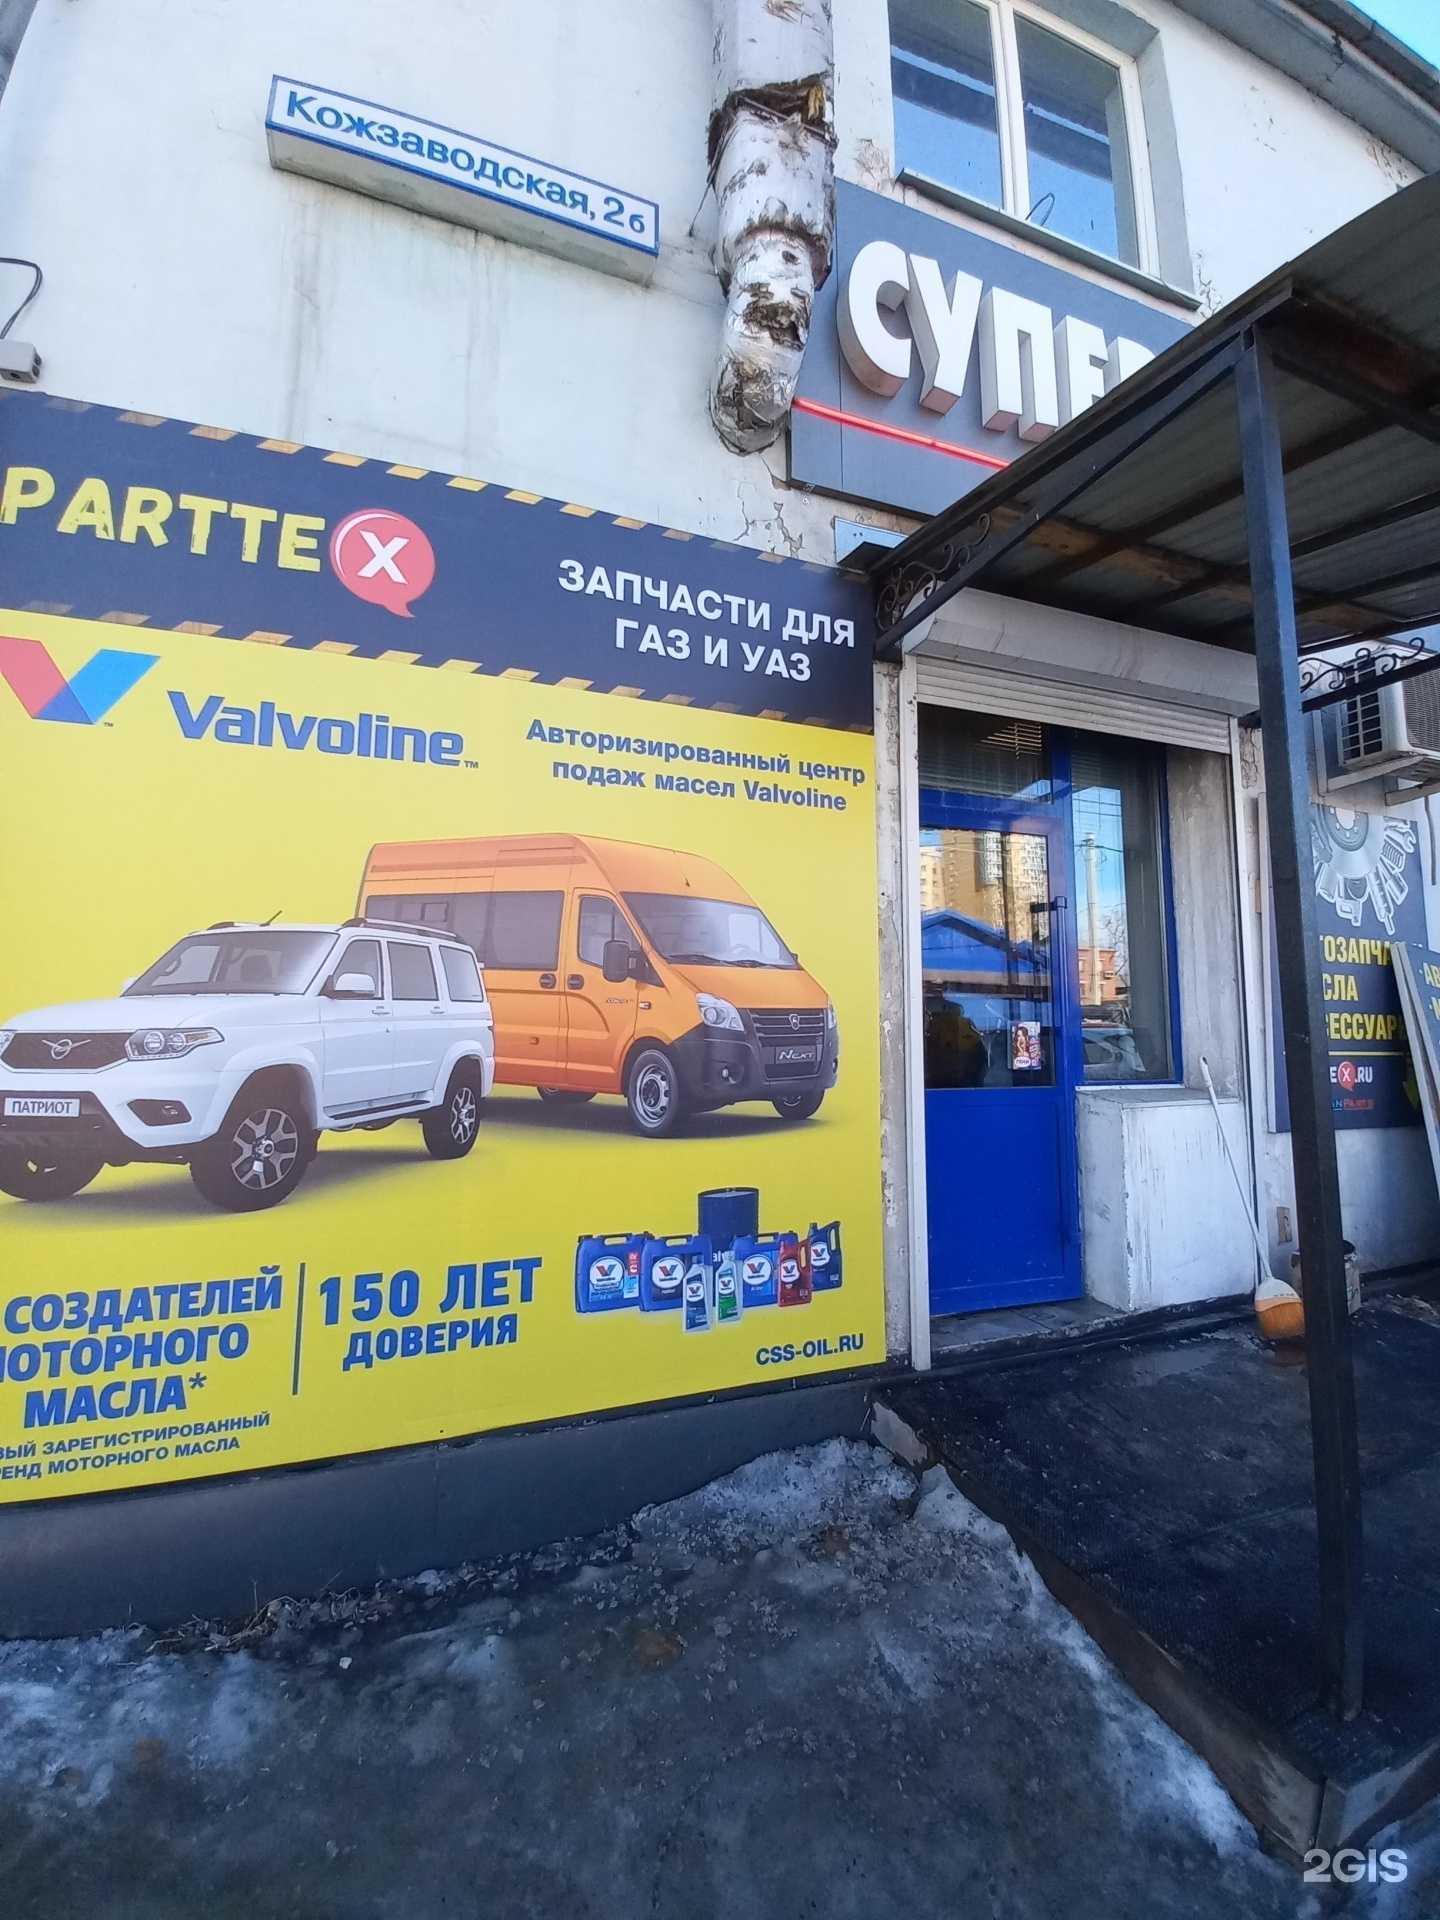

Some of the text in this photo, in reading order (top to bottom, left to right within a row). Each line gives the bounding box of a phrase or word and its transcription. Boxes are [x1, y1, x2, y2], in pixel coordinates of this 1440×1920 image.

[287, 90, 646, 233] Кожзаводская, 2б
[558, 559, 855, 648] ЗАПЧАСТИ ДЛЯ
[615, 618, 812, 682] ГАЗ И УАЗ
[526, 718, 865, 786] Авторизированный центр
[552, 760, 847, 811] подаж масел Valvoline
[12, 1100, 73, 1114] ПАТРИОТ
[3, 1265, 283, 1335] СОЗДАТЕЛЕЙ
[319, 1257, 543, 1326] 150 ЛЕТ
[342, 1313, 518, 1372] ДОВЕРИЯ
[755, 1333, 864, 1366] CSS-OIL.RU
[0, 1436, 241, 1480] ЕНД МОТОРНОГО МАСЛА
[43, 1411, 271, 1455] ЗАРЕГИСТРИРОВАННЫЙ
